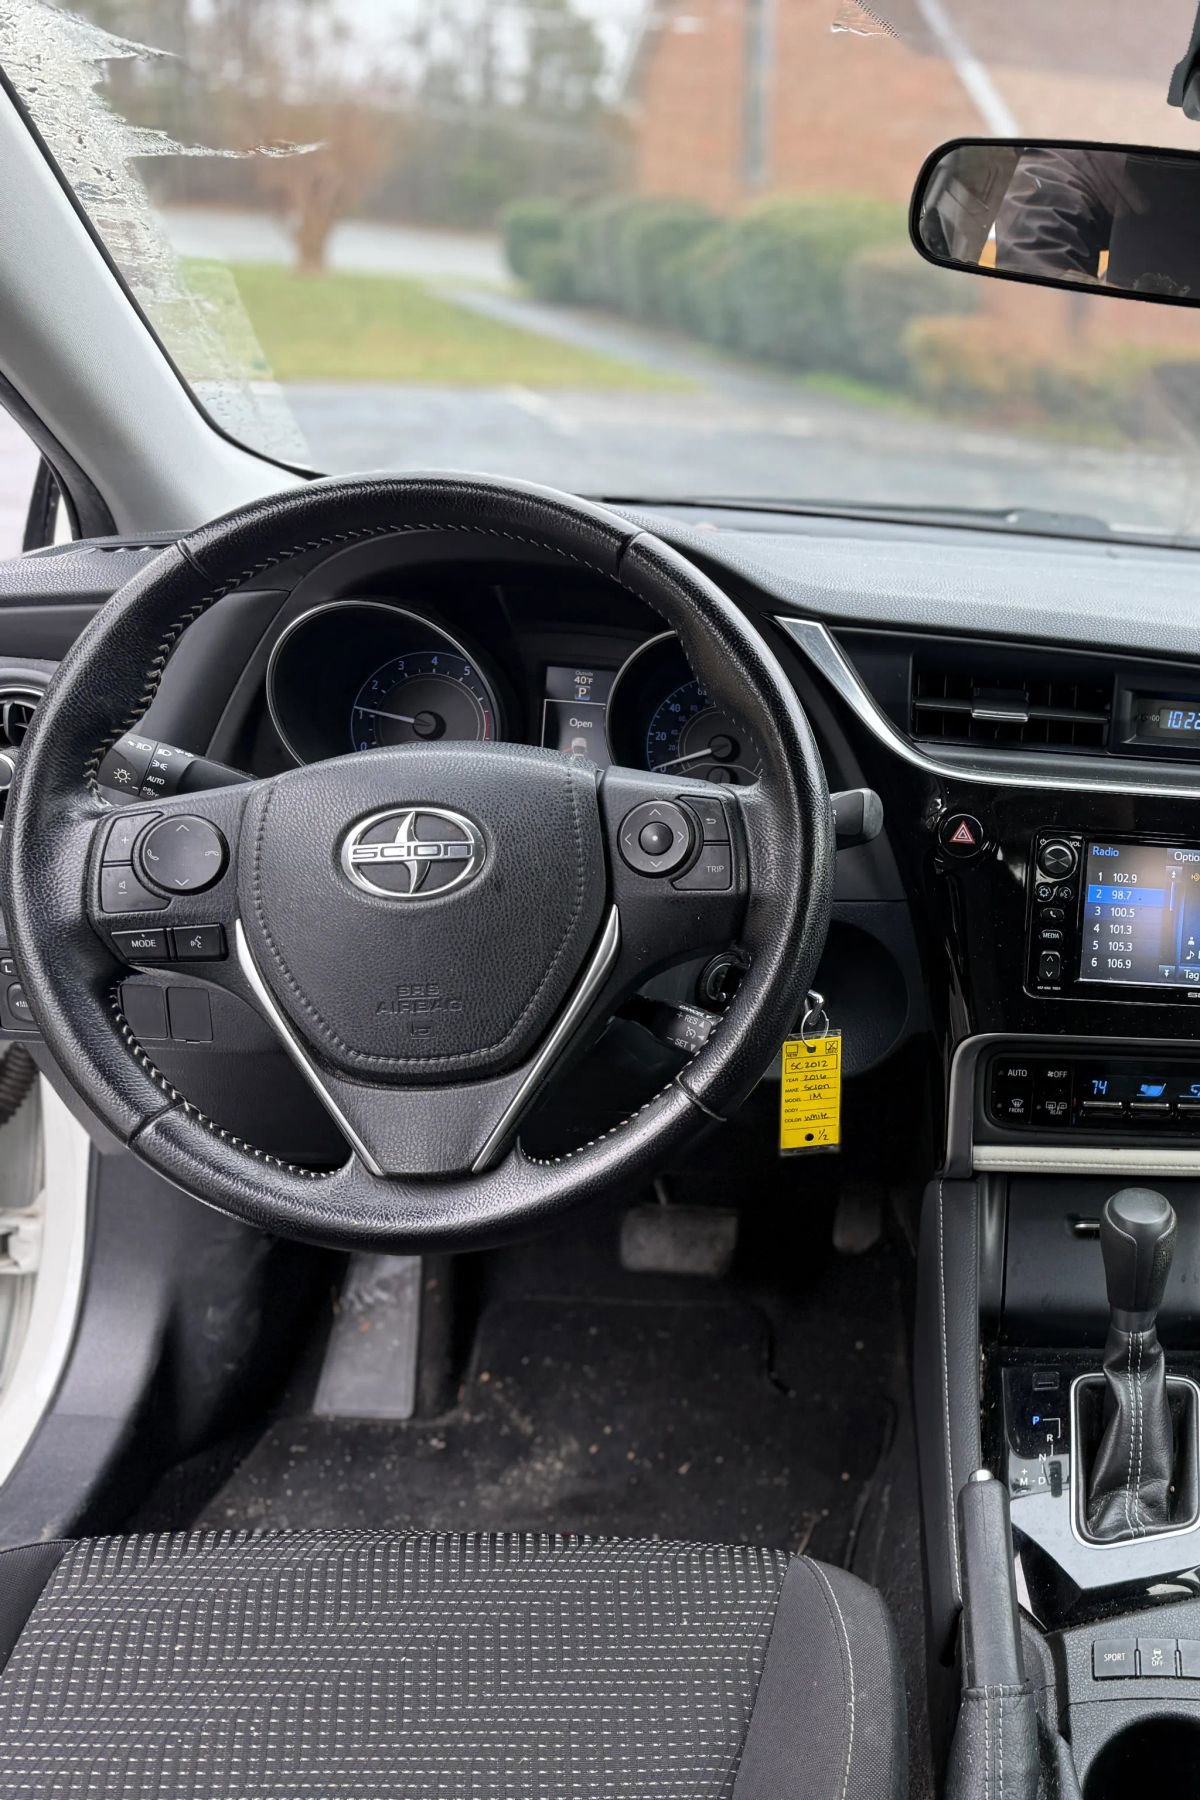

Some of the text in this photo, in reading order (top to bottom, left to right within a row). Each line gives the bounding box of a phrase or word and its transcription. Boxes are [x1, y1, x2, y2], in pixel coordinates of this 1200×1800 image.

[398, 661, 404, 670] 3
[432, 656, 438, 665] 4
[464, 666, 471, 676] 5
[372, 680, 378, 690] 2
[671, 704, 681, 713] 40
[570, 718, 593, 728] Open
[656, 732, 667, 741] 20
[147, 776, 165, 785] AUTO
[352, 843, 472, 860] SCION
[1092, 846, 1120, 857] Radio
[706, 865, 725, 873] TRIP
[1113, 873, 1138, 883] 102.9
[1096, 889, 1132, 900] 2 98.7
[1095, 906, 1135, 918] 3 100.5
[1094, 924, 1132, 935] 4 101.3
[131, 939, 157, 948] MODE
[1093, 941, 1133, 952] 5 105.3
[1091, 958, 1132, 969] 6 106.9
[5, 965, 12, 973] L
[1184, 970, 1200, 981] Tag
[685, 1014, 698, 1025] RES
[675, 1038, 688, 1048] SET
[804, 1060, 828, 1068] 2012
[1008, 1069, 1027, 1077] AUTO
[1053, 1070, 1068, 1078] OFF
[1092, 1080, 1108, 1095] 74
[1032, 1415, 1040, 1425] P
[1046, 1434, 1054, 1442] R
[1038, 1453, 1047, 1462] N
[1020, 1477, 1046, 1486] M D
[1103, 1653, 1126, 1662] SPORT
